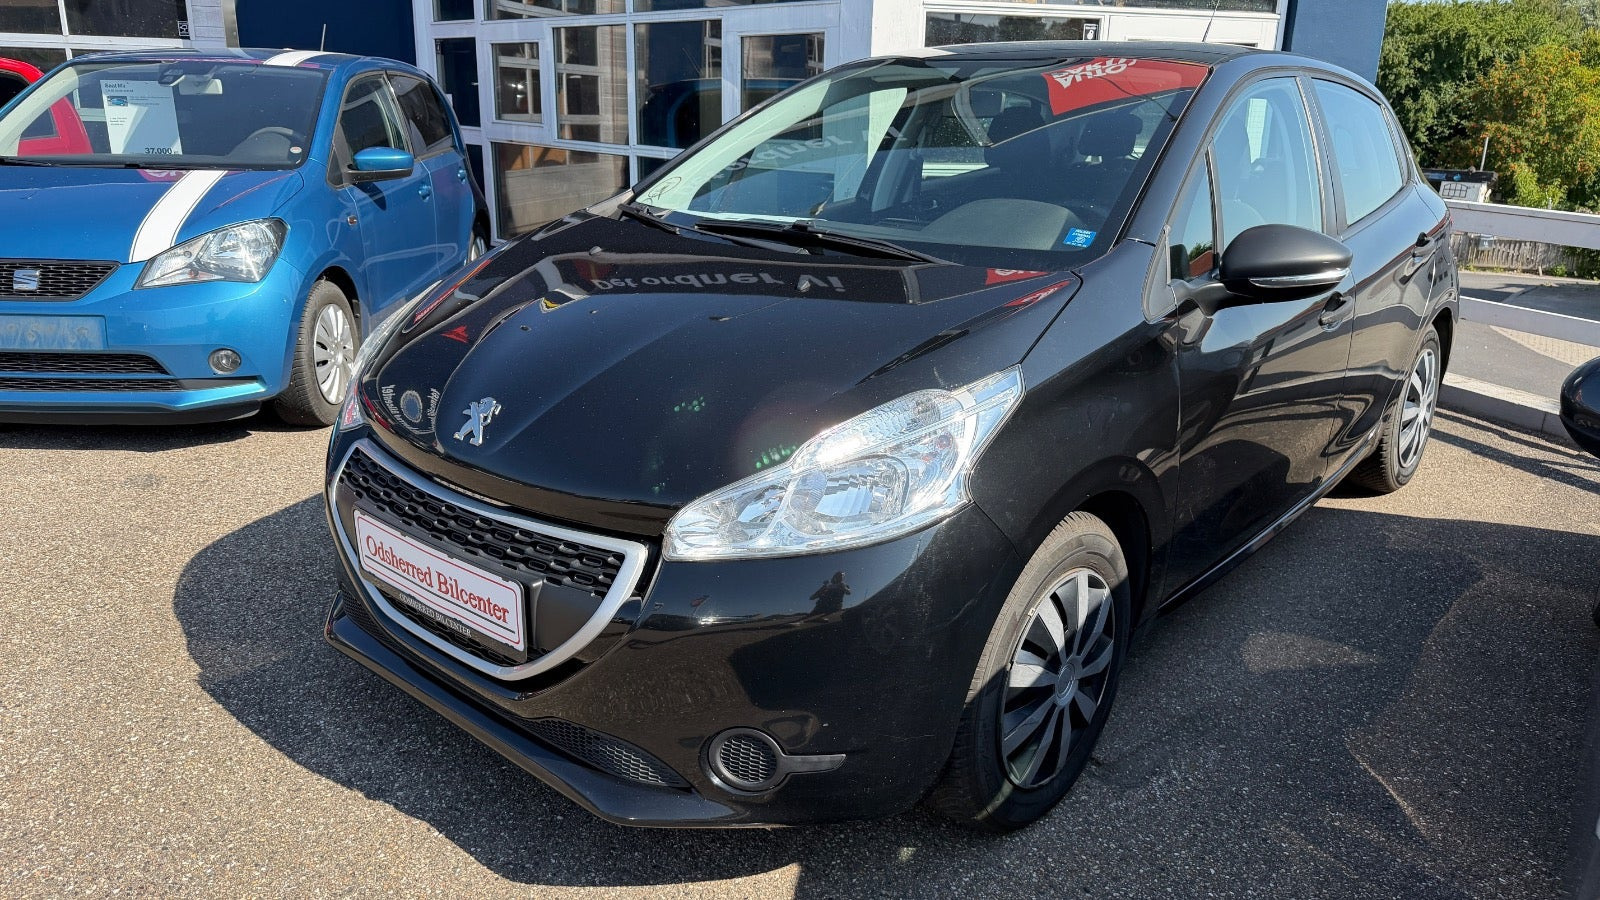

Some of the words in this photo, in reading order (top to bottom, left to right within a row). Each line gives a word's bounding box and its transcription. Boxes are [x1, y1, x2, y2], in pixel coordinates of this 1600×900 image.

[366, 534, 433, 588] Odsherred
[435, 570, 510, 624] Bilcenter
[435, 610, 472, 638] BILCENTER
